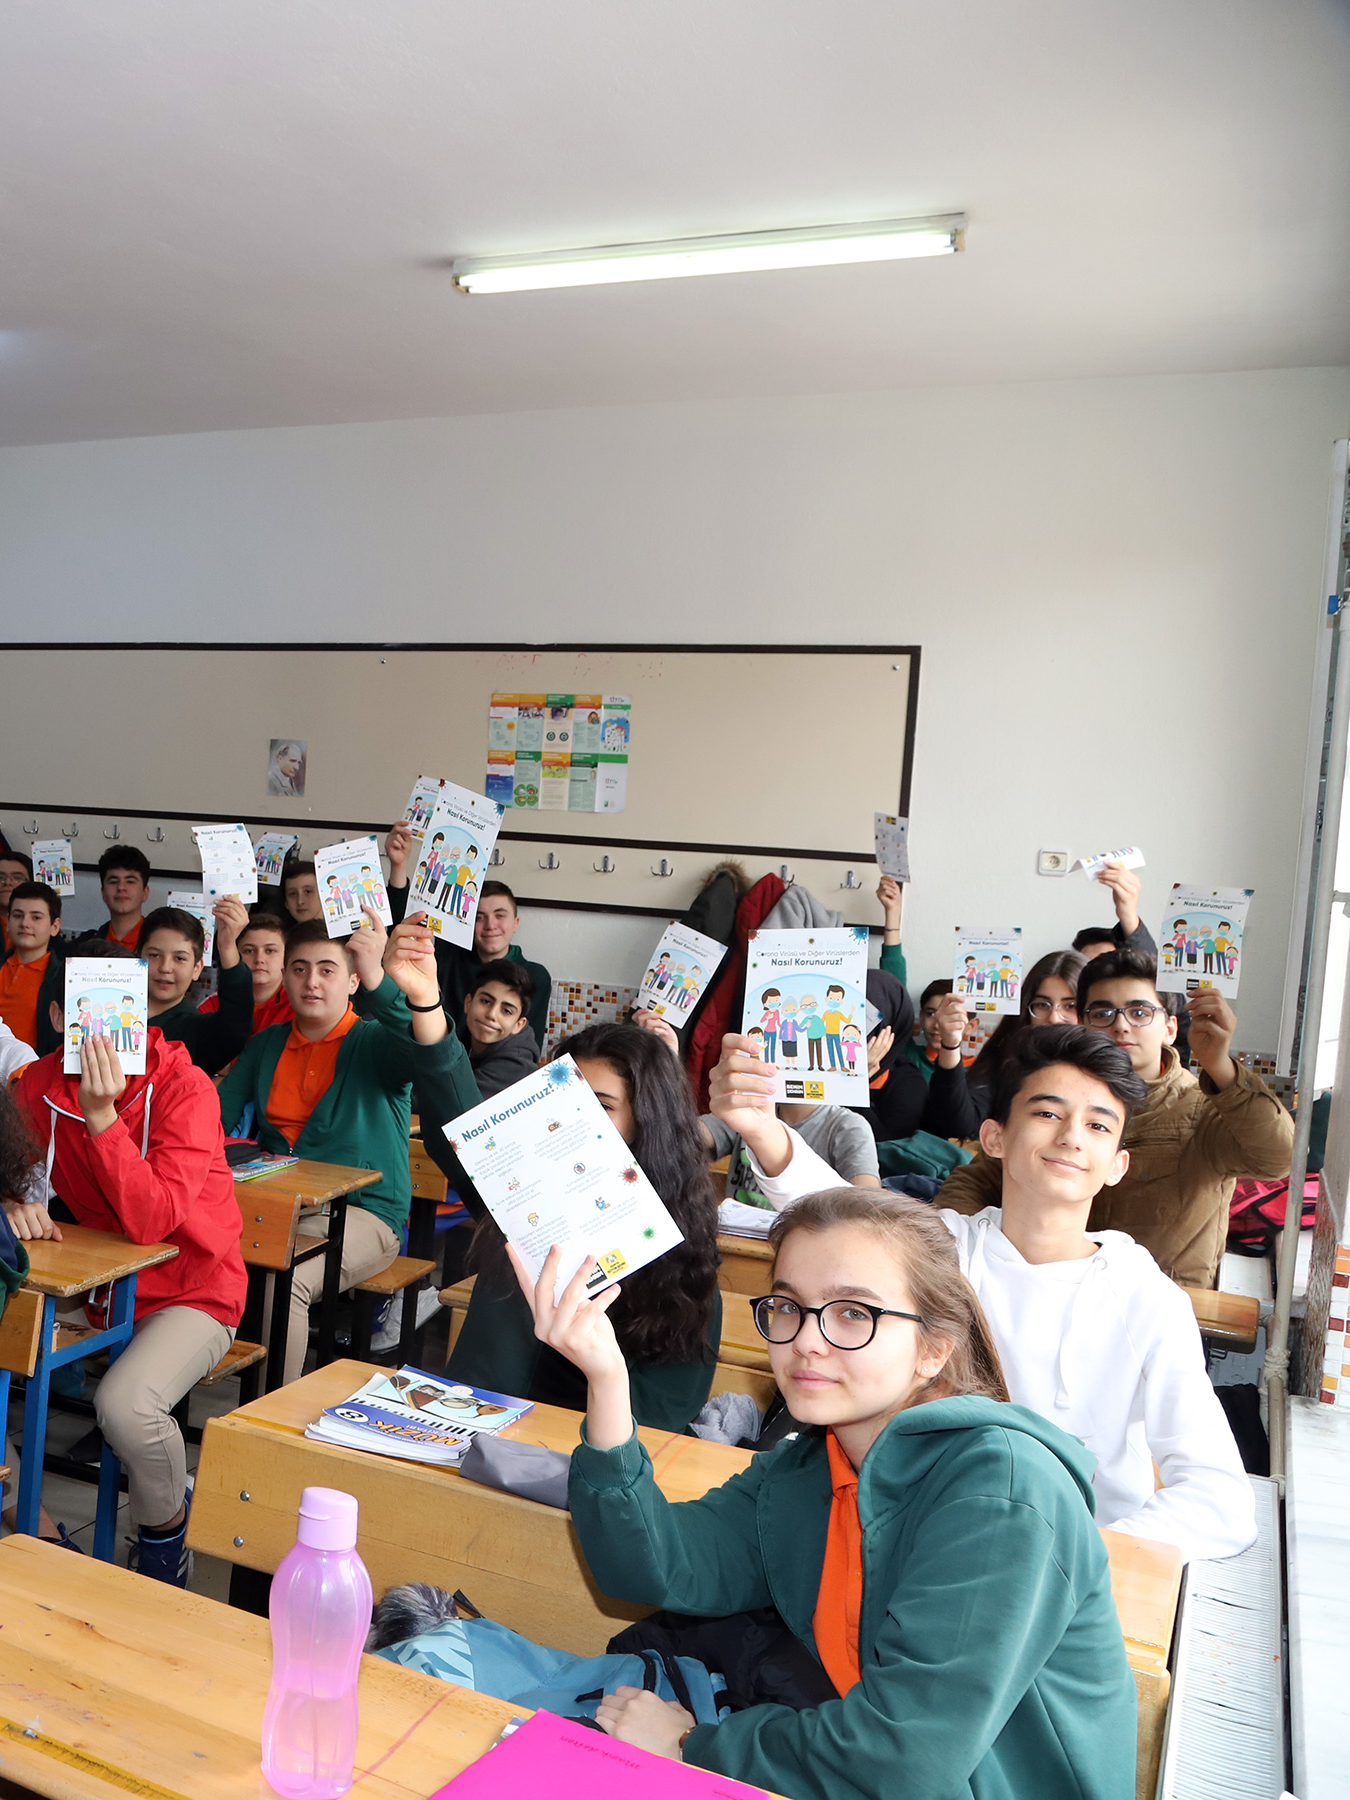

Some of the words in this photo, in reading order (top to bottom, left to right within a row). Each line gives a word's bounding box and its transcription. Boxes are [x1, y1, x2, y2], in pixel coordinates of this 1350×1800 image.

[771, 958, 792, 966] Nasıl
[795, 958, 842, 966] Korunuruz!
[461, 1119, 491, 1143] Nasıl
[490, 1082, 555, 1126] Korunuruz!
[339, 1410, 361, 1420] 8
[369, 1419, 463, 1447] MÜZİK
